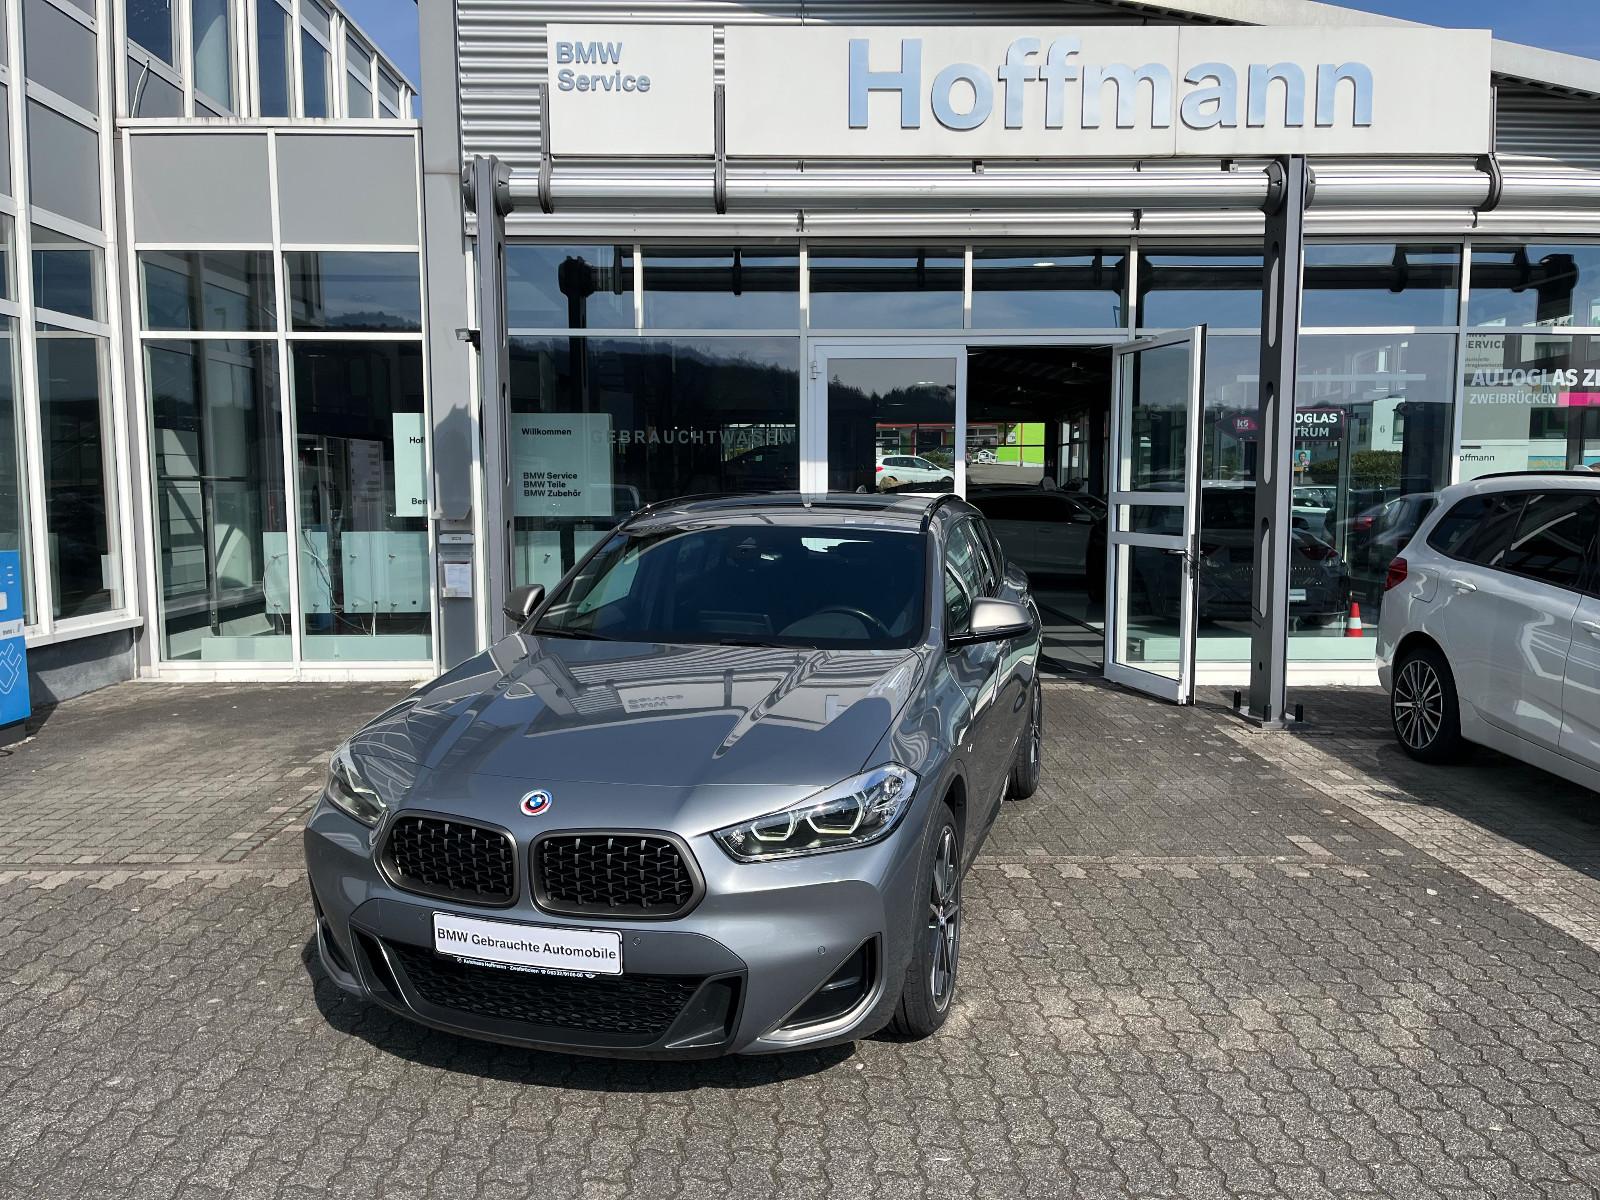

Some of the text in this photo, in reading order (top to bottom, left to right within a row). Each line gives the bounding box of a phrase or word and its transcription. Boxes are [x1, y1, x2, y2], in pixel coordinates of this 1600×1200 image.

[556, 41, 622, 64] BMW
[557, 68, 651, 92] Service
[848, 37, 1374, 131] Hoffmann
[1466, 340, 1504, 349] ERVIC
[1470, 368, 1578, 387] AUTOGLAS
[1470, 390, 1556, 404] ZWEIBRÜCKEN
[521, 427, 572, 436] Willkommen
[1459, 454, 1495, 462] offmann
[523, 472, 578, 480] BMW Service
[547, 489, 581, 497] Zubehör
[437, 928, 617, 959] BMW Gebrauchte Automobile
